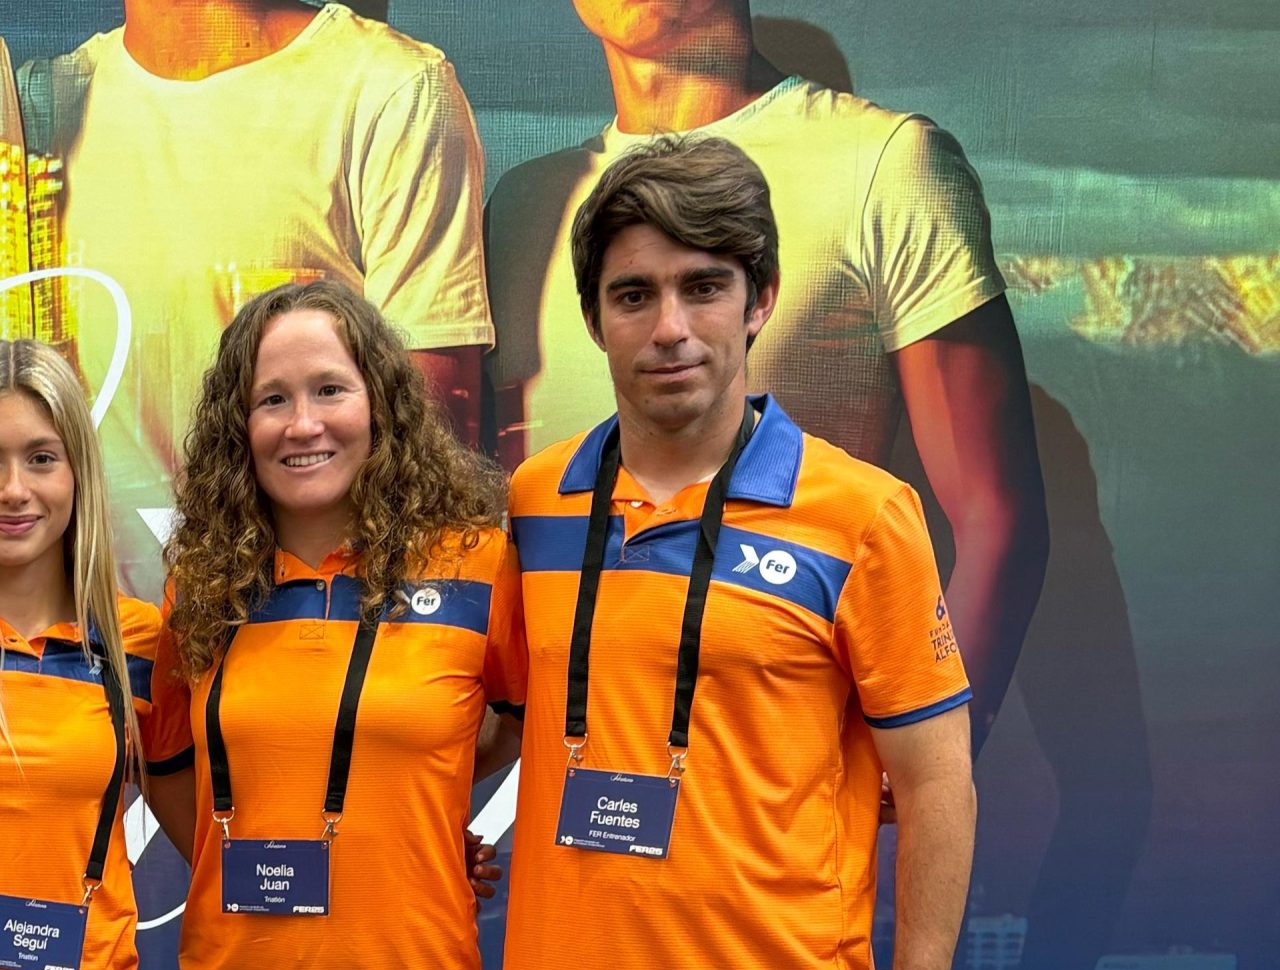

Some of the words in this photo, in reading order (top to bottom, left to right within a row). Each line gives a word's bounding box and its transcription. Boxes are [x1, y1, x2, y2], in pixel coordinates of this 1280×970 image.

[766, 559, 791, 575] Fer
[597, 796, 638, 813] Carles
[590, 810, 640, 829] Fuentes
[589, 829, 602, 838] FER
[602, 831, 636, 842] Entrenador
[256, 863, 294, 877] Noelia
[260, 878, 289, 890] Juan
[4, 919, 60, 938] Alejandra
[13, 934, 48, 951] Seguí
